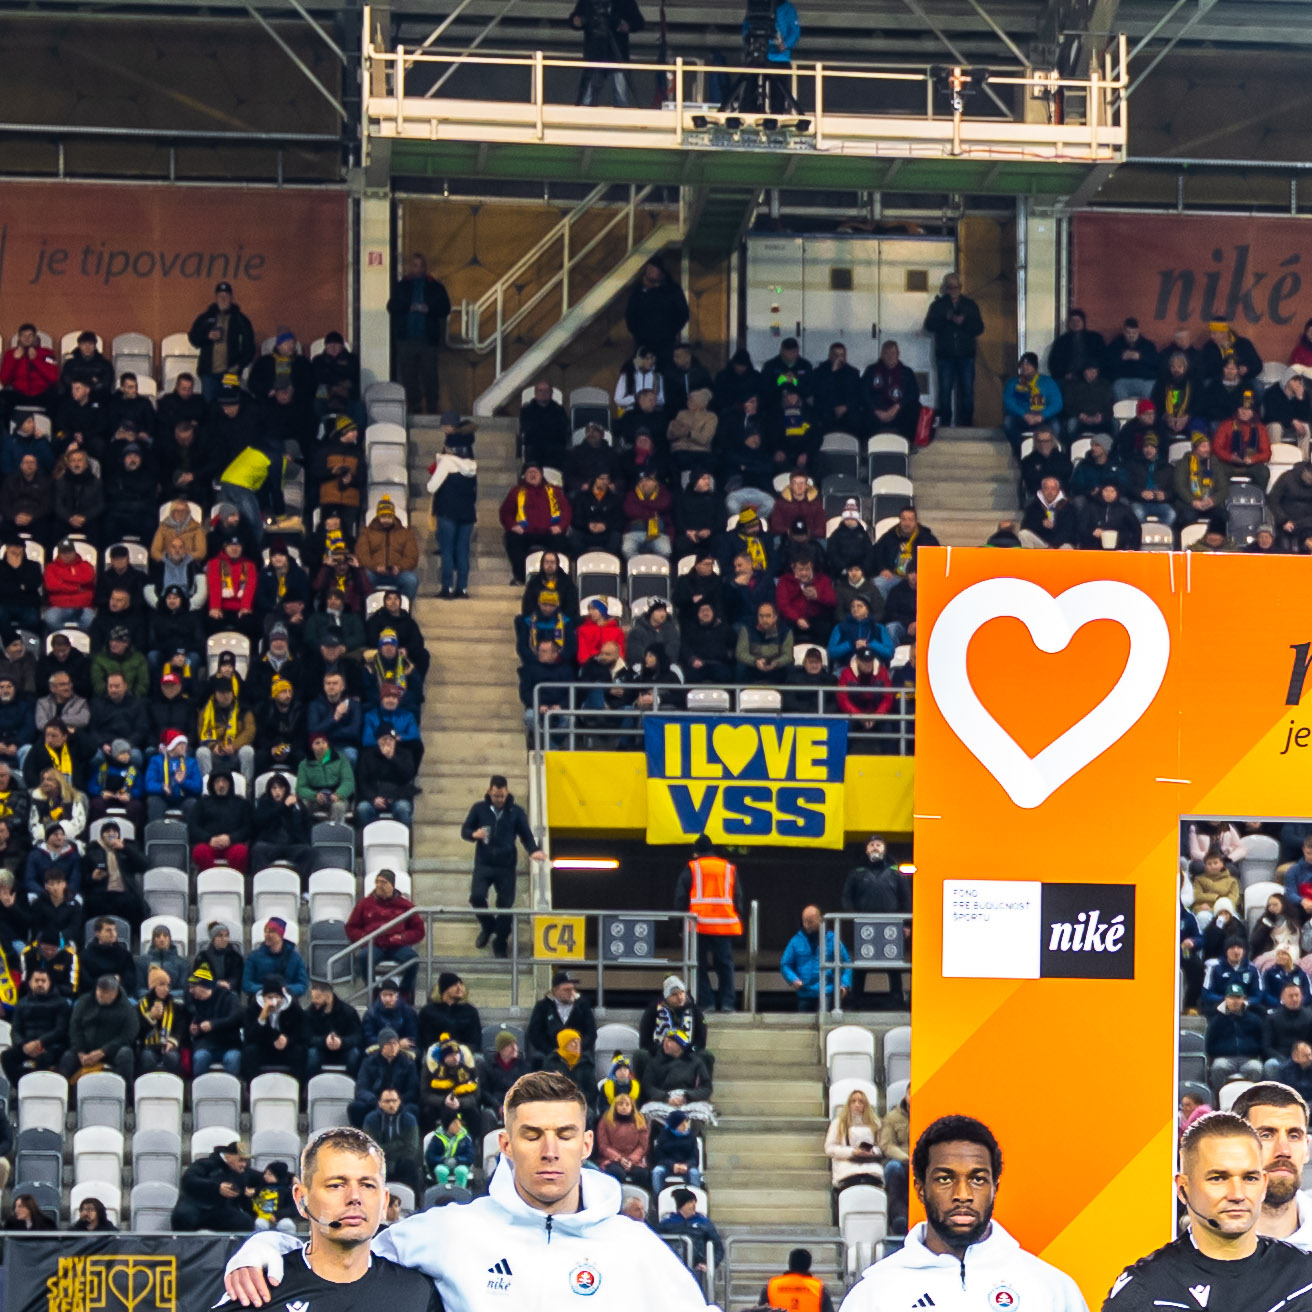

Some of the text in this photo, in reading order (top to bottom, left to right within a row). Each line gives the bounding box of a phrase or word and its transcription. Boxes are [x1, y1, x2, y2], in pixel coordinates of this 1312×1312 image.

[29, 239, 267, 286] je tipovanie
[1153, 244, 1301, 326] niké
[663, 723, 683, 777] I
[1280, 721, 1311, 755] je
[667, 784, 826, 838] VSS
[542, 922, 577, 954] C4
[1048, 910, 1125, 952] niké
[46, 1276, 86, 1299] SME
[57, 1256, 86, 1278] MY
